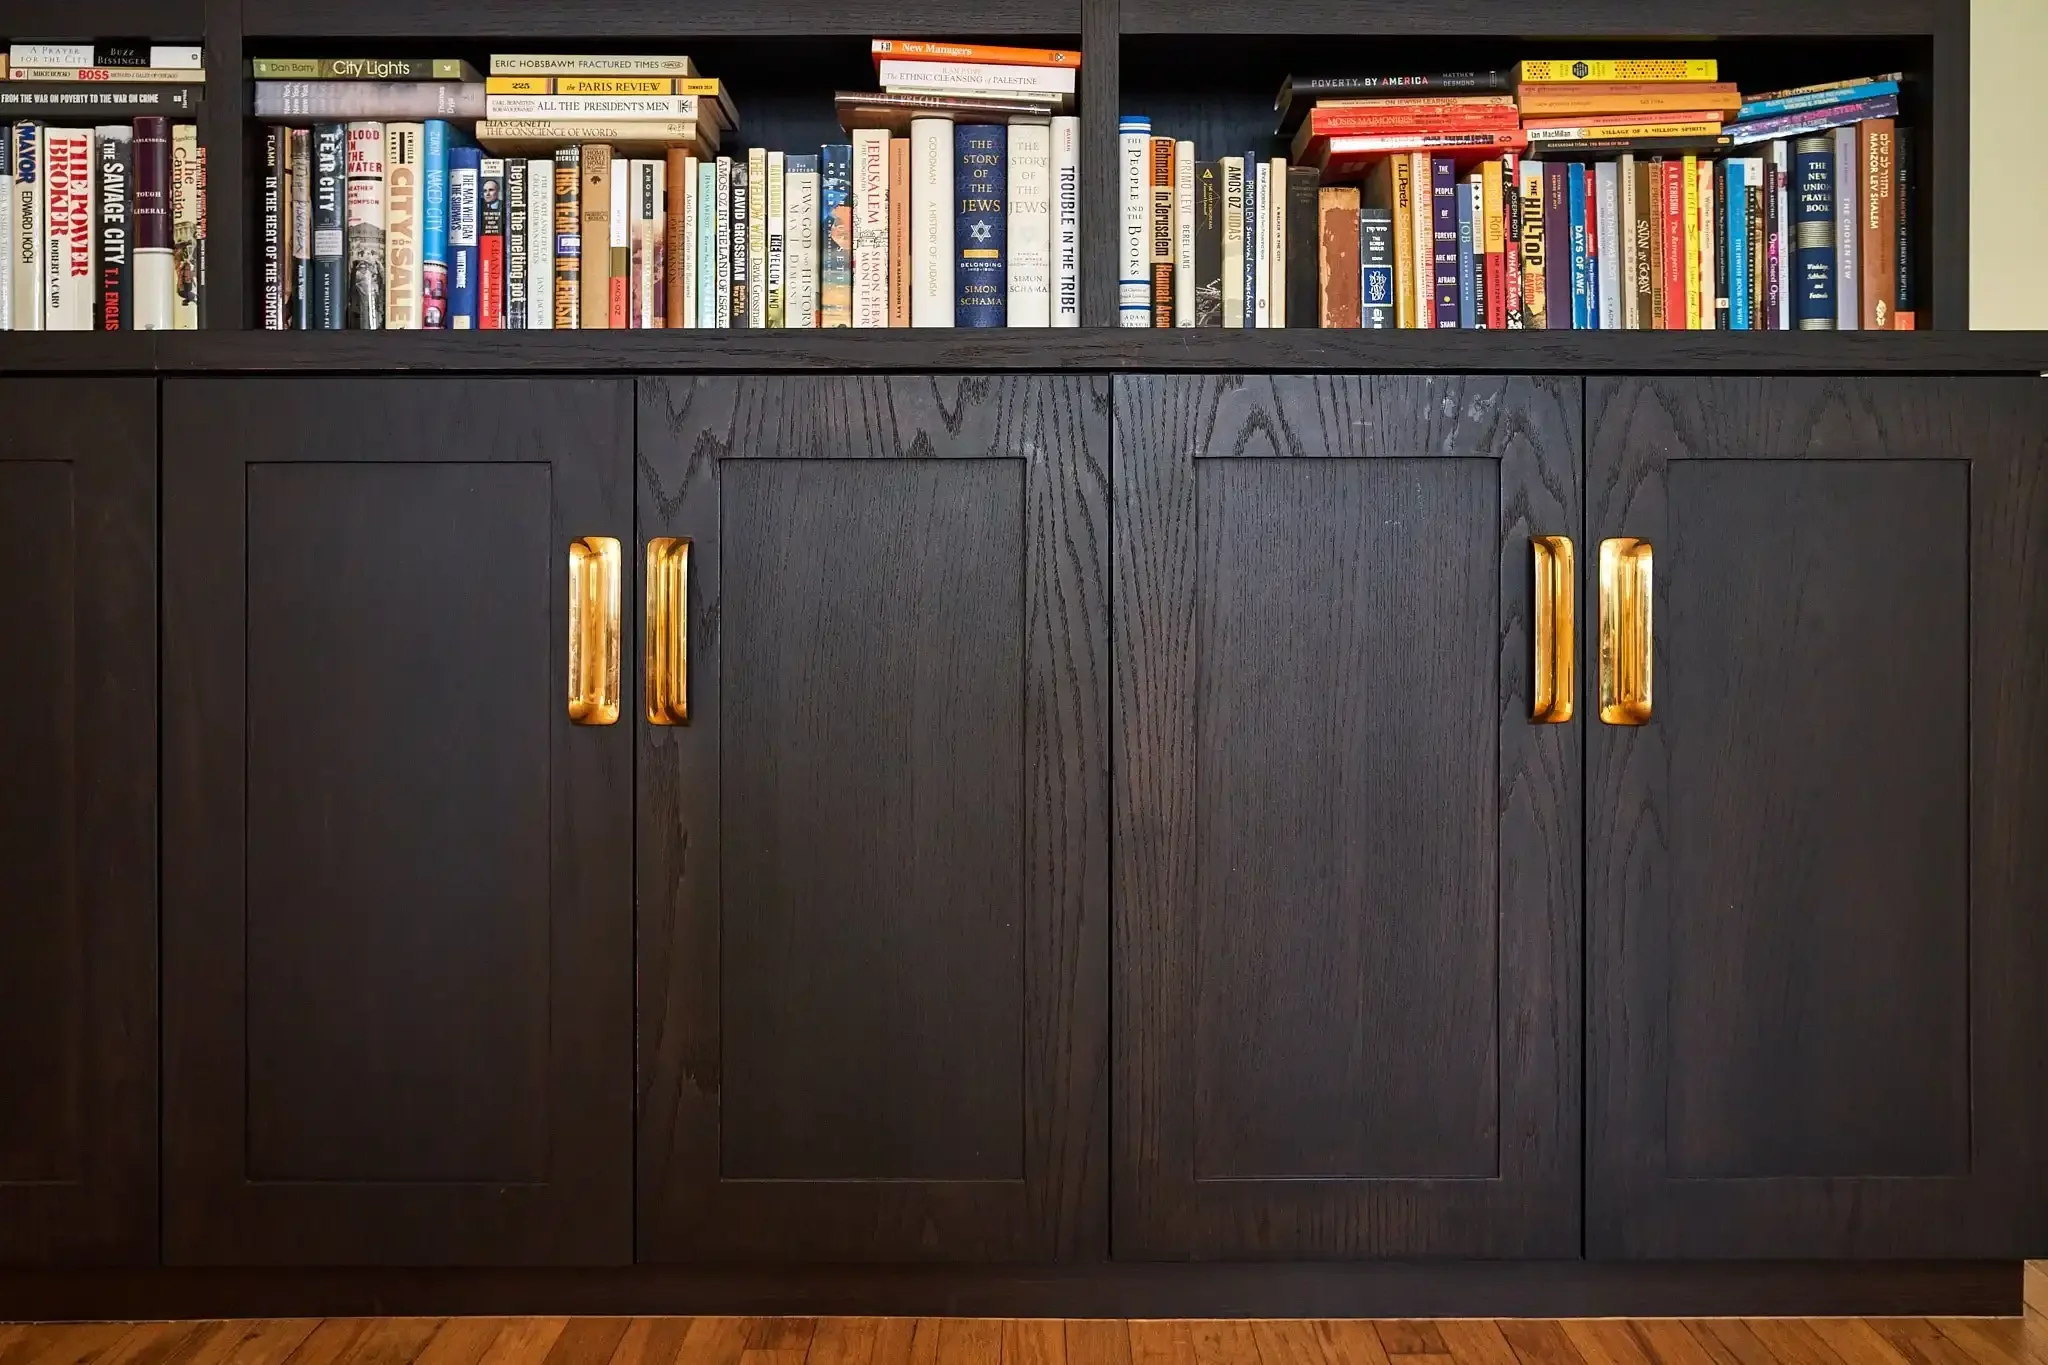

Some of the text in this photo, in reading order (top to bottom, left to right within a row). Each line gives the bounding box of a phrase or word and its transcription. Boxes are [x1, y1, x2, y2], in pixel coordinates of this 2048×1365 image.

[98, 56, 146, 65] BISSINGER
[902, 43, 923, 52] New
[925, 45, 972, 56] Managers
[78, 70, 109, 80] BOSS
[293, 64, 314, 72] Barry
[333, 60, 410, 77] City Lights
[495, 60, 659, 68] ERIC HOBSBAWM FRACTURED TIMES
[566, 82, 660, 91] the PARIS REVIEW
[900, 74, 932, 82] ETHNIC
[934, 74, 983, 83] CLEANSING
[993, 76, 1037, 85] PALESTINE
[1365, 78, 1378, 86] BY
[1382, 77, 1428, 86] AMERICA
[1, 94, 158, 104] FROM THE WAR ON POVERTY TO THE WAR ON CRIME
[538, 102, 669, 111] ALL THE PRESIDENT'S MEN
[430, 131, 440, 156] ZUKIN
[486, 128, 617, 137] THE CONSCIENCE OF WORDS
[17, 126, 36, 184] MAYOR
[267, 135, 275, 166] FLAMM
[1017, 142, 1039, 150] THE
[184, 160, 196, 184] The
[320, 133, 335, 211] FEAR CITY
[349, 163, 382, 172] WATER
[964, 155, 999, 165] STORY
[1012, 157, 1048, 166] STORY
[50, 138, 69, 236] BROKER
[173, 147, 183, 219] Campaign
[266, 177, 276, 188] IN
[865, 140, 880, 224] JERUSALEM
[974, 170, 988, 178] OF
[1128, 150, 1141, 201] PEOPLE
[1181, 160, 1191, 214] PRIMO LEVI
[1870, 133, 1879, 229] MAHZOR LEV SHALEM
[427, 170, 442, 232] NAKED CITY
[970, 184, 992, 192] THE
[1016, 186, 1039, 194] THE
[1155, 140, 1168, 256] Eichmann in Jerusalem
[22, 191, 32, 229] EDWARD
[70, 135, 88, 277] THE POWER
[104, 142, 125, 264] THE SAVAGE CITY
[266, 191, 276, 212] THE
[391, 168, 414, 235] CITY
[452, 184, 461, 231] THE SUBWAYS
[463, 174, 473, 239] THE MAN WHO RAN
[645, 203, 652, 216] OZ
[751, 155, 763, 252] THE YELLOW WIND
[962, 200, 1000, 214] JEWS
[1009, 201, 1048, 216] JEWS
[1229, 166, 1241, 240] AMOS OZ JUDAS
[266, 215, 276, 242] HEAT
[511, 165, 526, 302] beyond the melting pot
[734, 189, 745, 280] DAVID GROSSMAN
[1061, 166, 1075, 314] TROUBLE IN THE TRIBE
[1461, 219, 1470, 242] JOB
[1490, 216, 1501, 241] Roth
[1524, 198, 1544, 265] HILLTOP
[1637, 220, 1649, 249] SATAN
[1843, 198, 1852, 279] THE CHOSEN FEW
[22, 237, 32, 263] KOCH
[266, 246, 276, 259] OF
[929, 247, 936, 259] OF
[1128, 226, 1142, 275] BOOKS
[1182, 225, 1190, 269] BEREL LANG
[1575, 225, 1584, 295] DAYS OF AWE
[266, 262, 276, 282] THE
[770, 235, 782, 309] THE YELLOW WIND
[1639, 263, 1651, 295] GORAY
[1768, 233, 1778, 306] Open Closed Open
[390, 248, 414, 322] SALE
[616, 305, 621, 315] OZ
[961, 298, 1002, 306] SCHAMA
